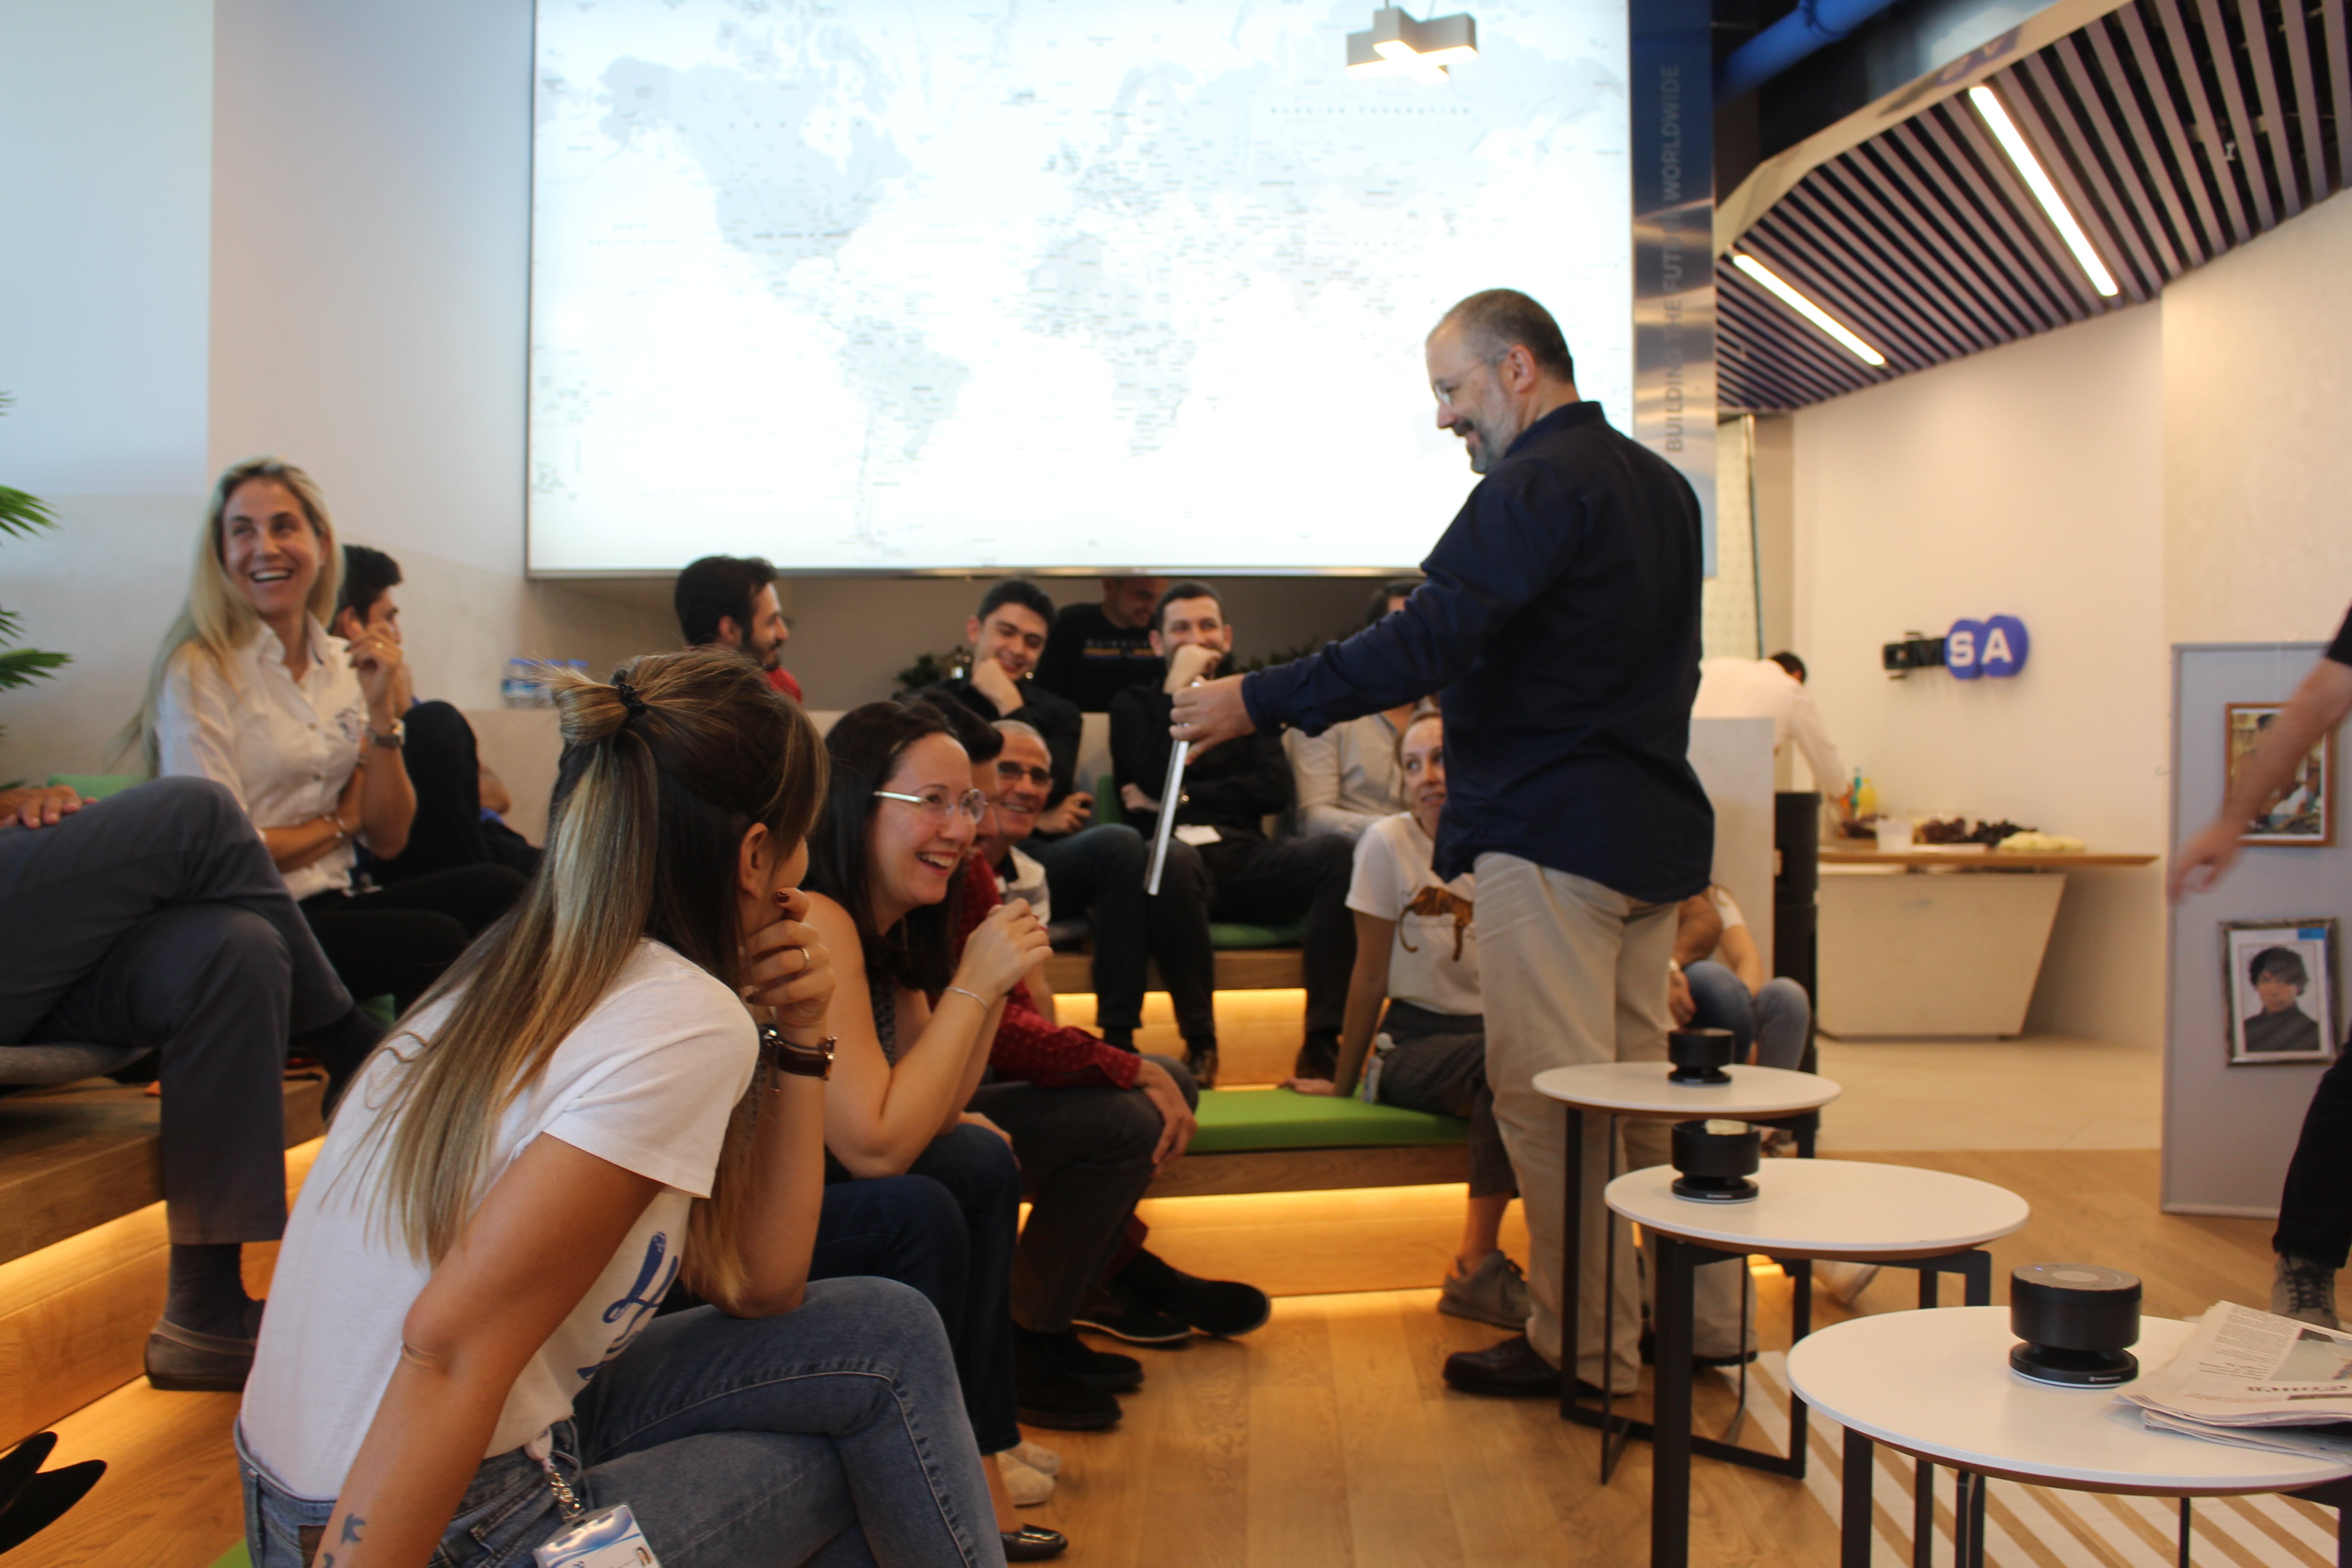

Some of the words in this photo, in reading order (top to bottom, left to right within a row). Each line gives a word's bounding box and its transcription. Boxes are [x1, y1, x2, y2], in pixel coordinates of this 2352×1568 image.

[1660, 65, 1681, 201] WORLDWIDE
[1664, 299, 1683, 341] THE
[1664, 351, 1684, 452] BUILDING
